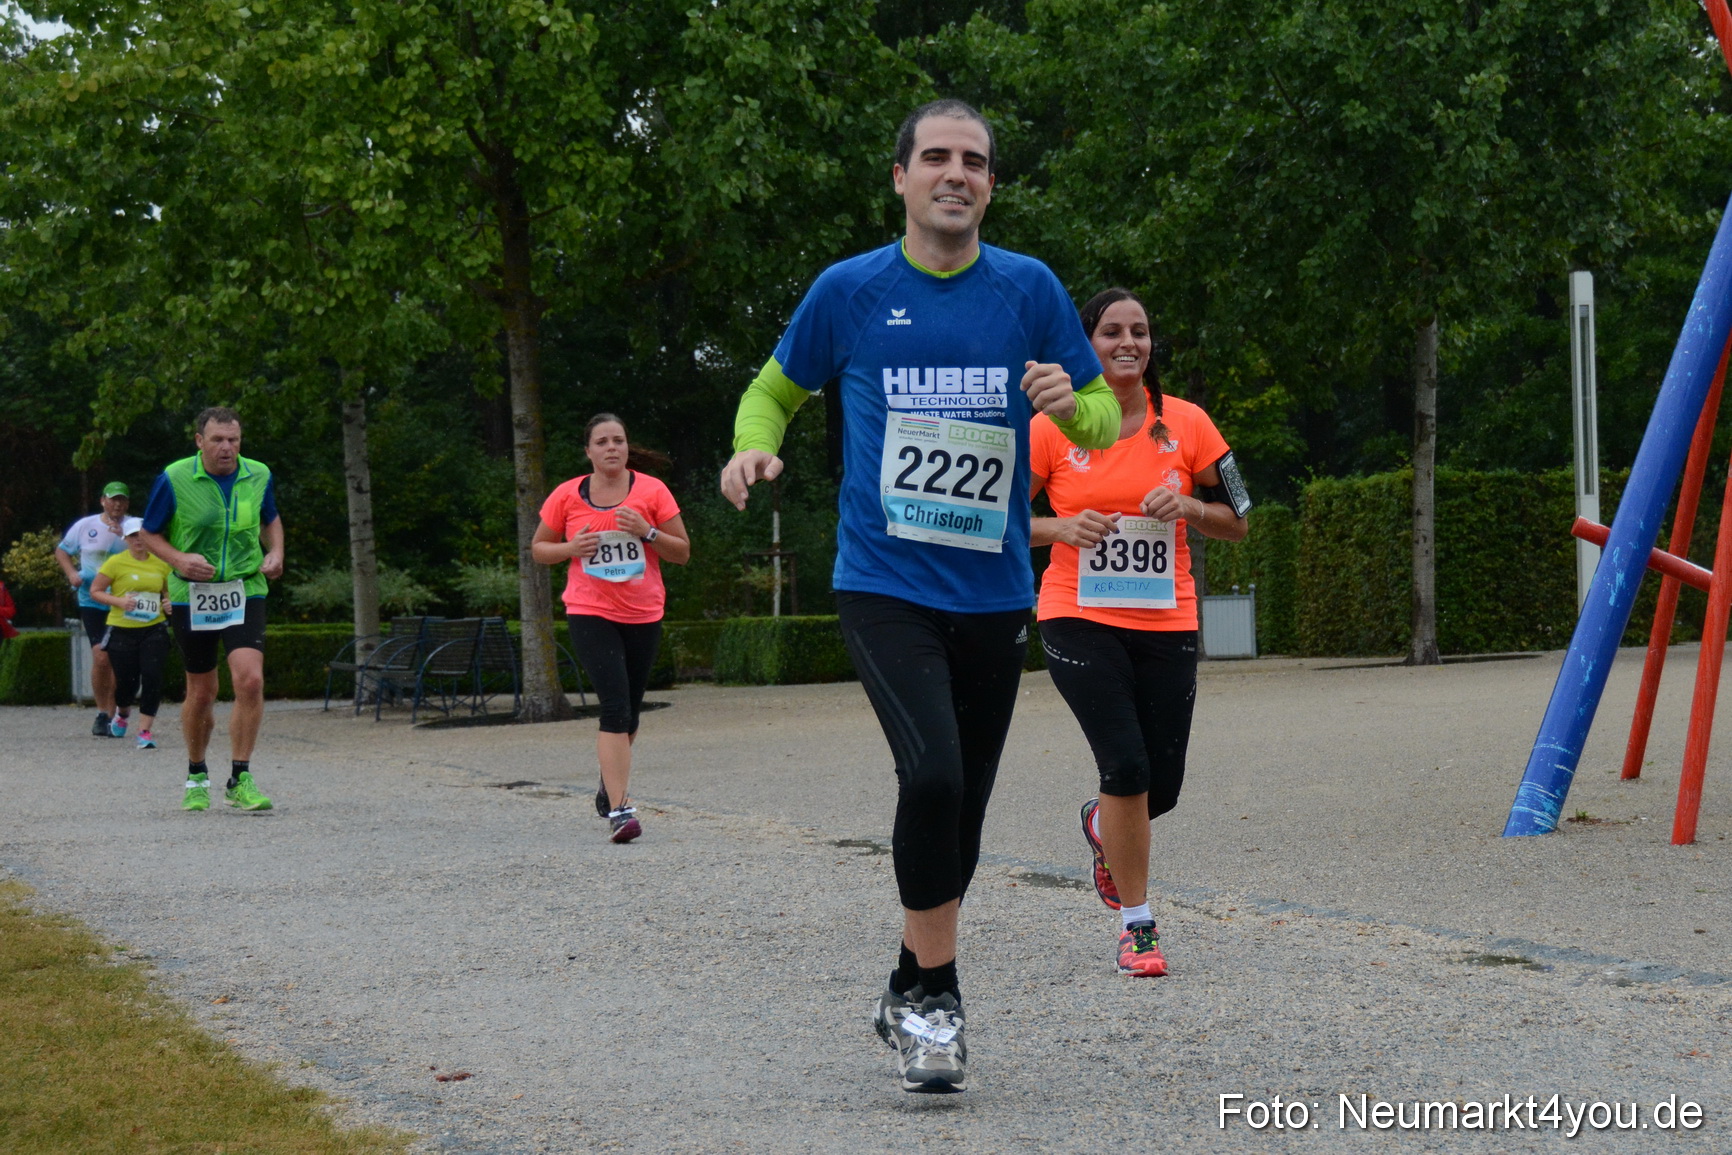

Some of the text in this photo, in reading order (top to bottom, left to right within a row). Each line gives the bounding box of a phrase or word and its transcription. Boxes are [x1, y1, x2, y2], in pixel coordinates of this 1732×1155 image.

[887, 318, 911, 326] erima
[883, 367, 1009, 394] HUBER
[910, 396, 1005, 406] TECHNOLOGY
[942, 411, 972, 419] WATER
[974, 410, 1006, 418] Solutions
[897, 427, 940, 439] NeuerMarkt
[948, 424, 1009, 448] BOCK
[894, 445, 1004, 503] 2222
[903, 504, 983, 533] Christoph
[1124, 519, 1168, 532] BOCK
[589, 541, 639, 565] 2818
[1089, 538, 1167, 574] 3398
[604, 568, 626, 576] Petra
[1094, 581, 1151, 593] KERSTIN
[133, 599, 157, 612] 670
[197, 591, 241, 611] 2360
